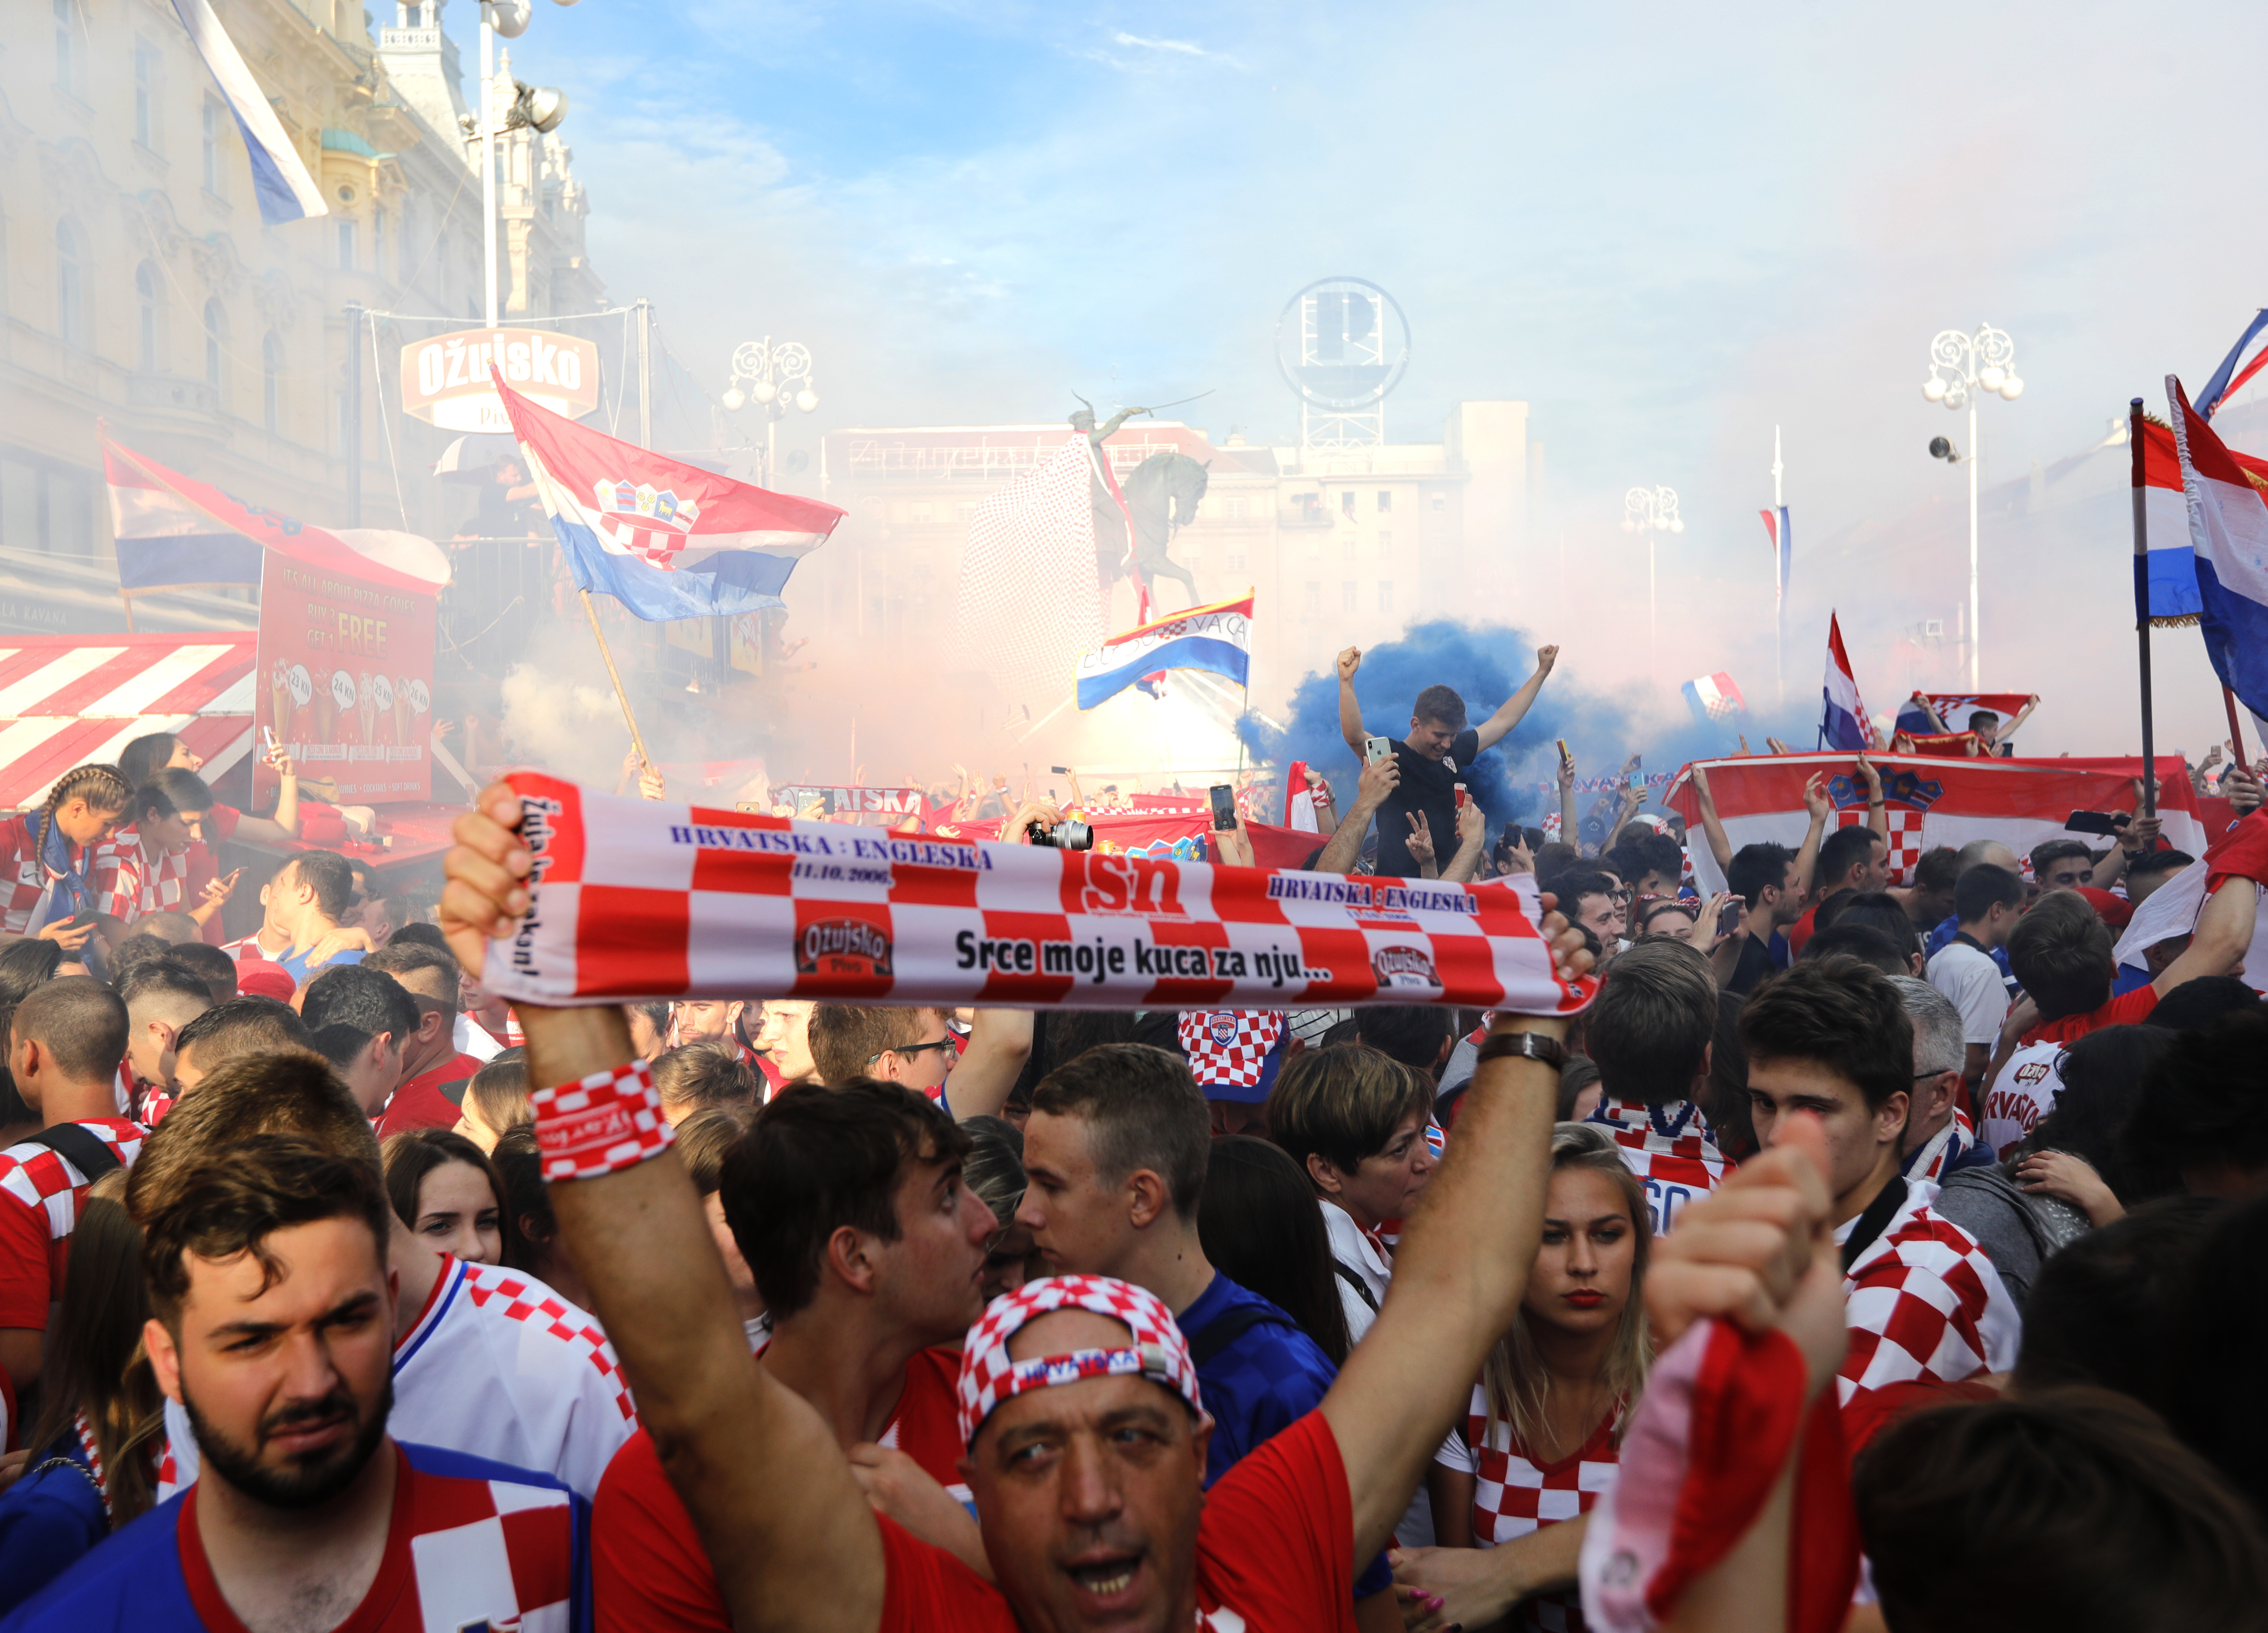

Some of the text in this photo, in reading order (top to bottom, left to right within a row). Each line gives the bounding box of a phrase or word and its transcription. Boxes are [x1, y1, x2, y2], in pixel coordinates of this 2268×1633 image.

[418, 333, 581, 396] Ožujsko
[282, 568, 415, 617] IT'S ALL ABOUT PIZZA CONES
[25, 605, 67, 627] KAVANA
[308, 603, 335, 626] BUY 3
[307, 629, 333, 651] GET 1
[338, 611, 387, 659] FREE
[291, 672, 310, 697] 23 KN
[334, 678, 354, 701] 24 KN
[375, 682, 392, 705] 25 KN
[411, 687, 428, 708] 26 KN
[339, 784, 357, 794] WINES
[363, 783, 386, 793] COCKTAILS
[392, 782, 403, 791] SOFT
[404, 782, 420, 791] DRINKS
[670, 825, 832, 856] HRVATSKA
[854, 838, 993, 870] ENGLESKA
[1268, 876, 1371, 906] HRVATSKA
[1386, 886, 1476, 914] ENGLESKA
[957, 930, 1332, 987] Srce moje kuca za nju...
[1025, 1349, 1137, 1384] HRVATSKA
